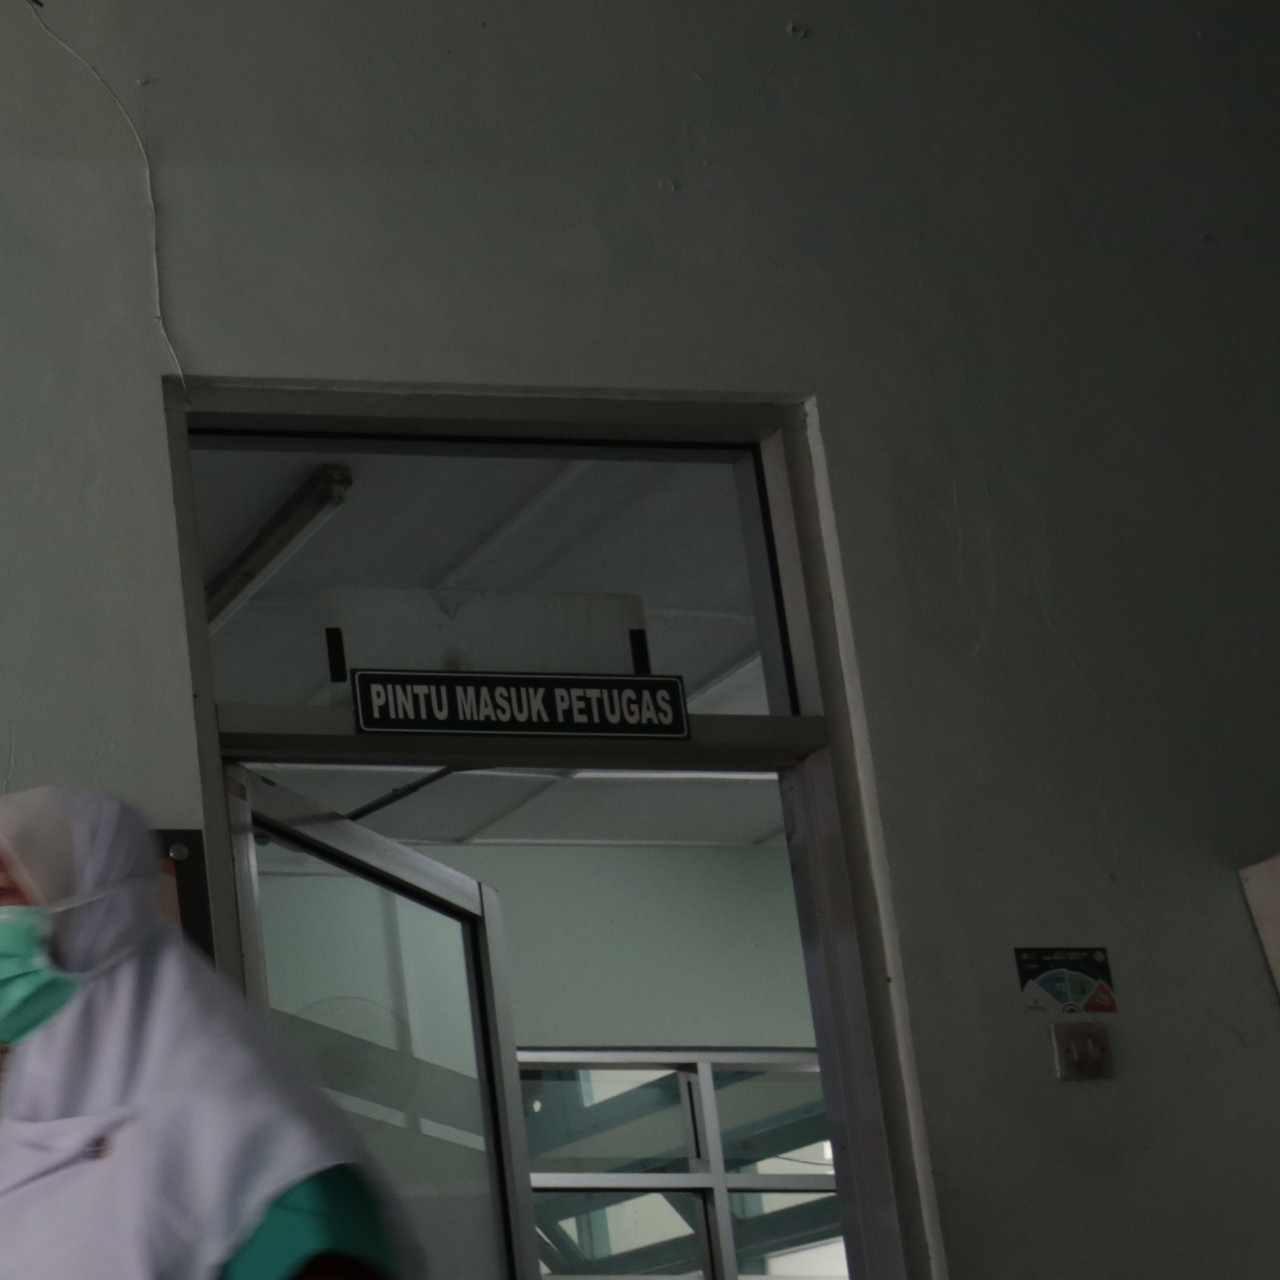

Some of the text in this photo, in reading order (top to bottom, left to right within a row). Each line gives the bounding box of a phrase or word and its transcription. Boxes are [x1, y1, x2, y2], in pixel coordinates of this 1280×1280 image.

[371, 684, 673, 724] PINTU MASUK PETUGAS
